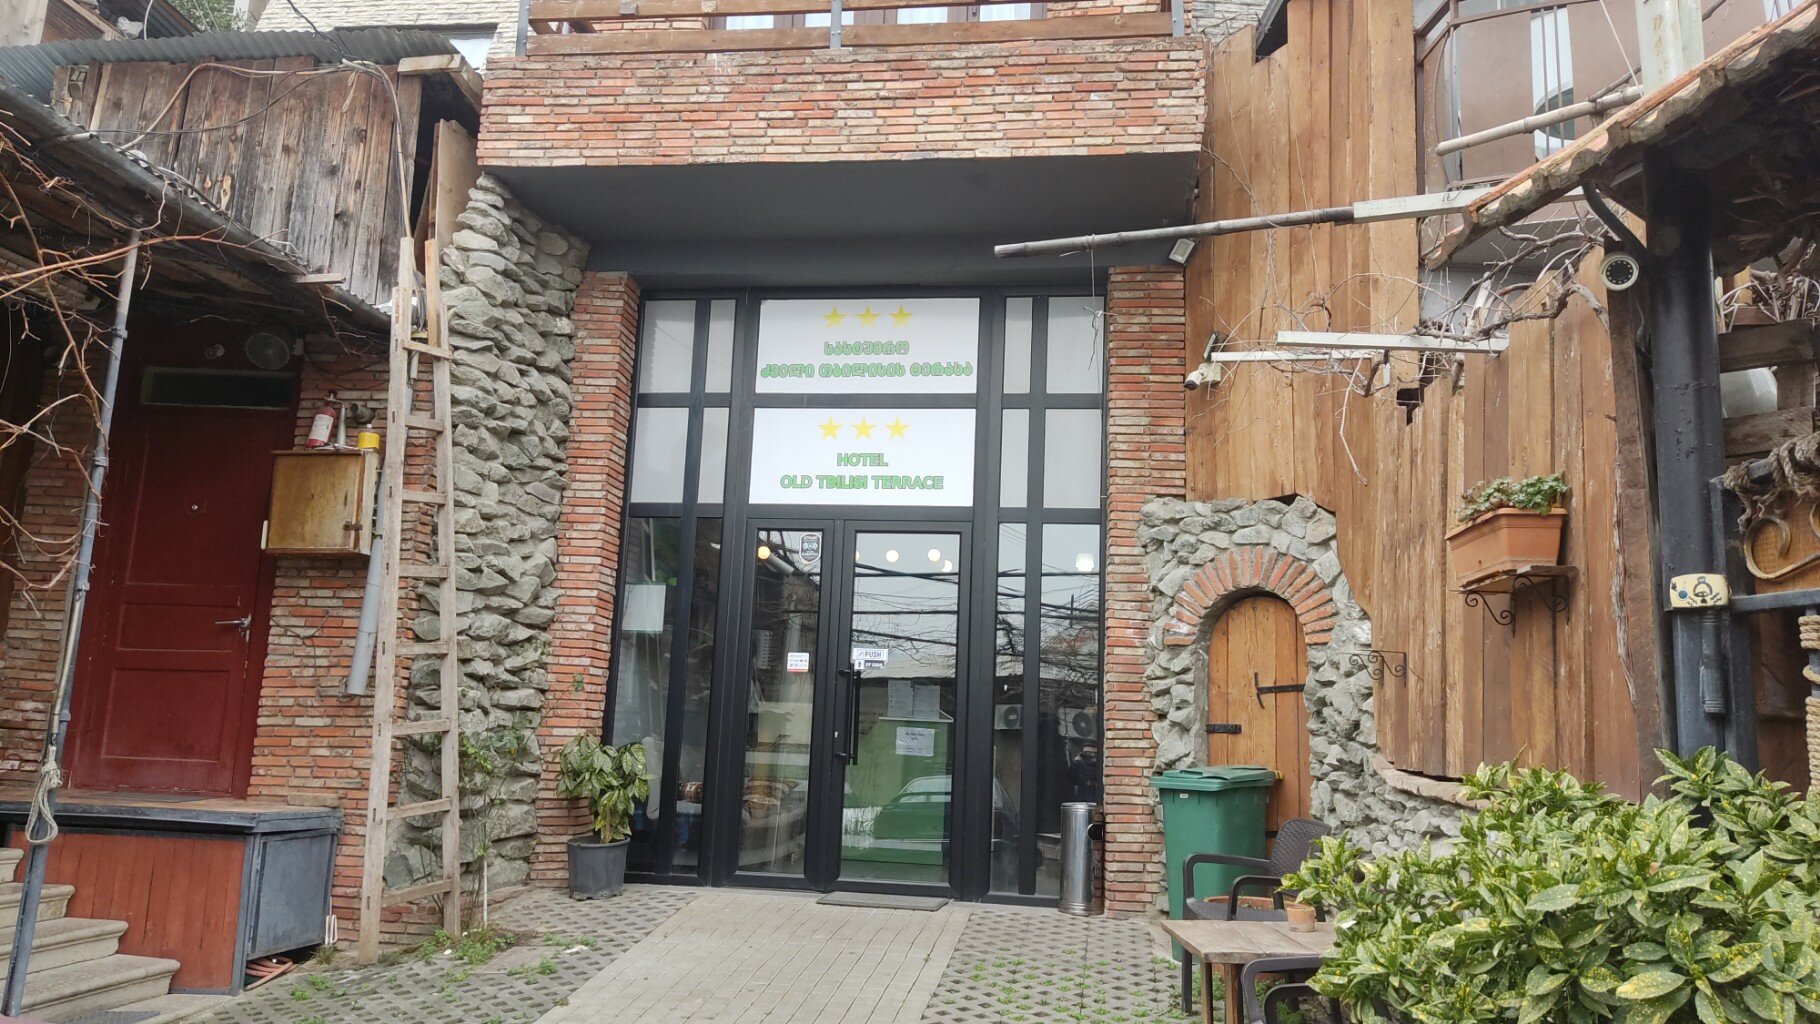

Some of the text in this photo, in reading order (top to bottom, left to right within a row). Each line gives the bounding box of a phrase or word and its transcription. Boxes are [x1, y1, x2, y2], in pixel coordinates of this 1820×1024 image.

[824, 341, 910, 356] სასტუმრო
[760, 361, 974, 379] ძველი თბილისის ტერასა
[837, 452, 889, 467] HOTEL
[780, 474, 944, 490] OLD TBILISI TERRACE
[864, 650, 882, 658] PUSH
